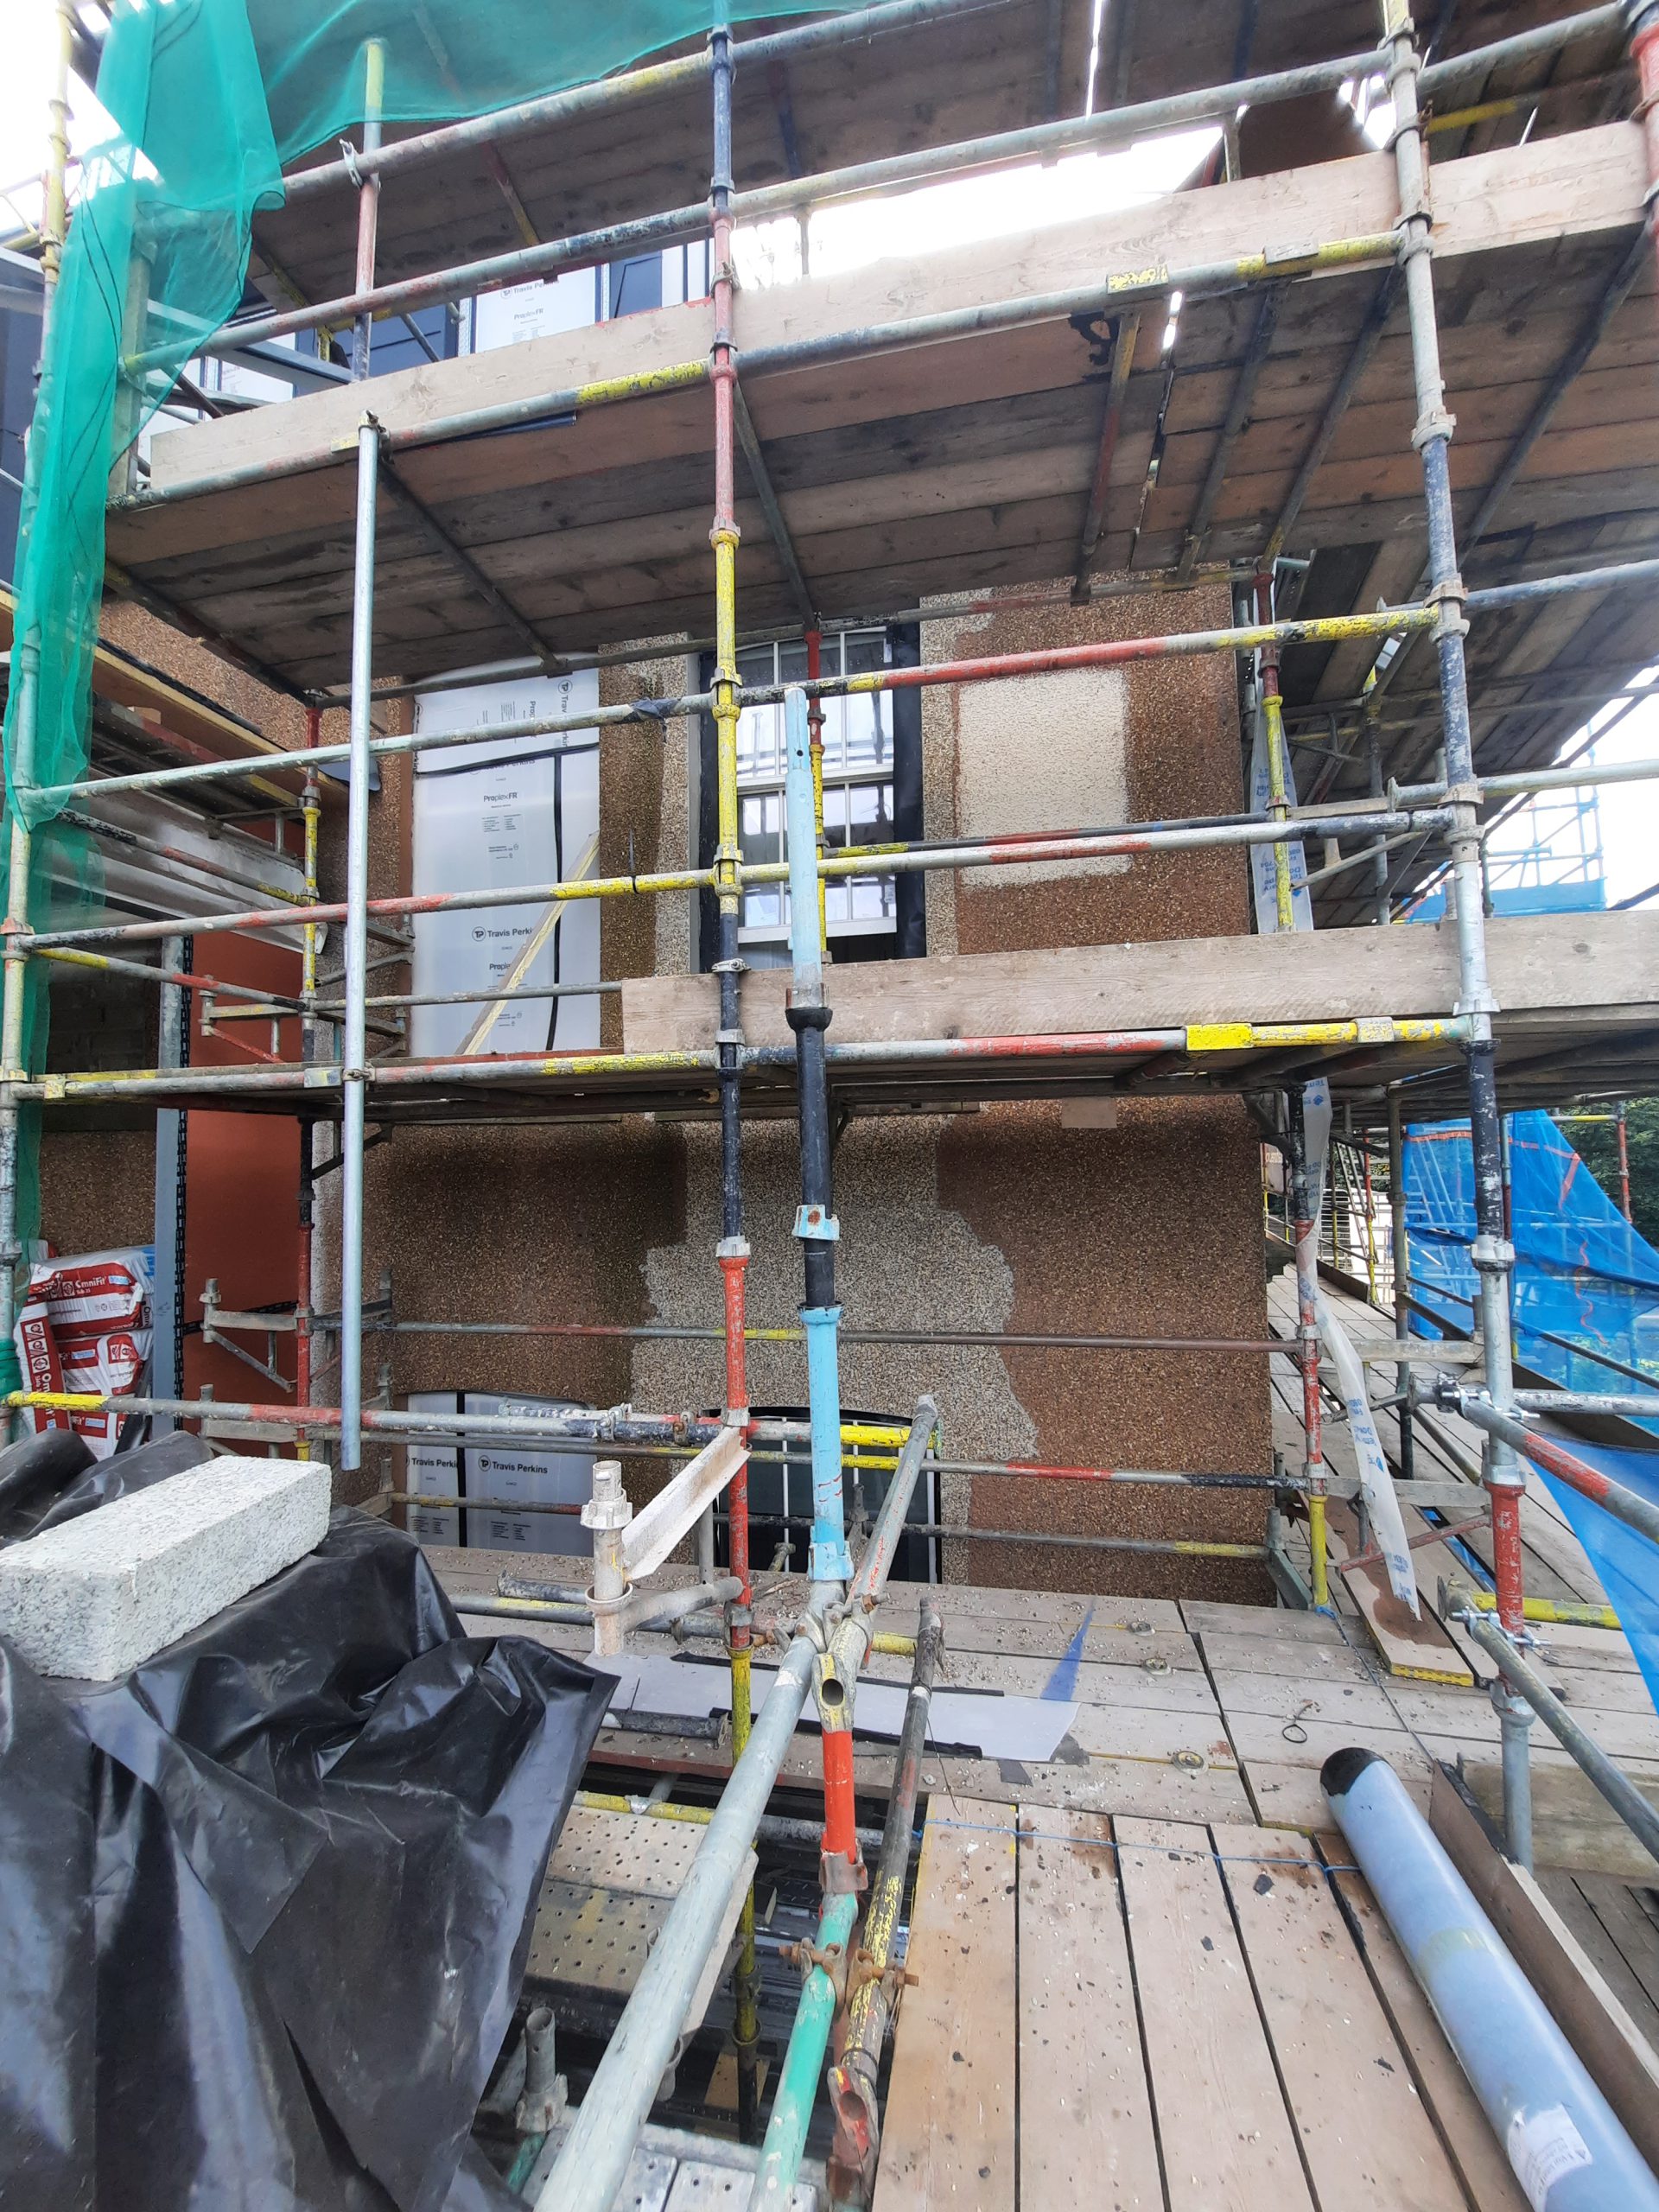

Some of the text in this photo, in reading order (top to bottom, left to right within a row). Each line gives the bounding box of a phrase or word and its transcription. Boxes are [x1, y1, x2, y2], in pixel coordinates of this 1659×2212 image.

[513, 285, 533, 295] Travis
[486, 929, 511, 938] Travis
[512, 927, 532, 937] Perki
[411, 1458, 457, 1468] Travis Perki
[492, 1461, 516, 1471] Travis
[517, 1463, 548, 1474] Perkins
